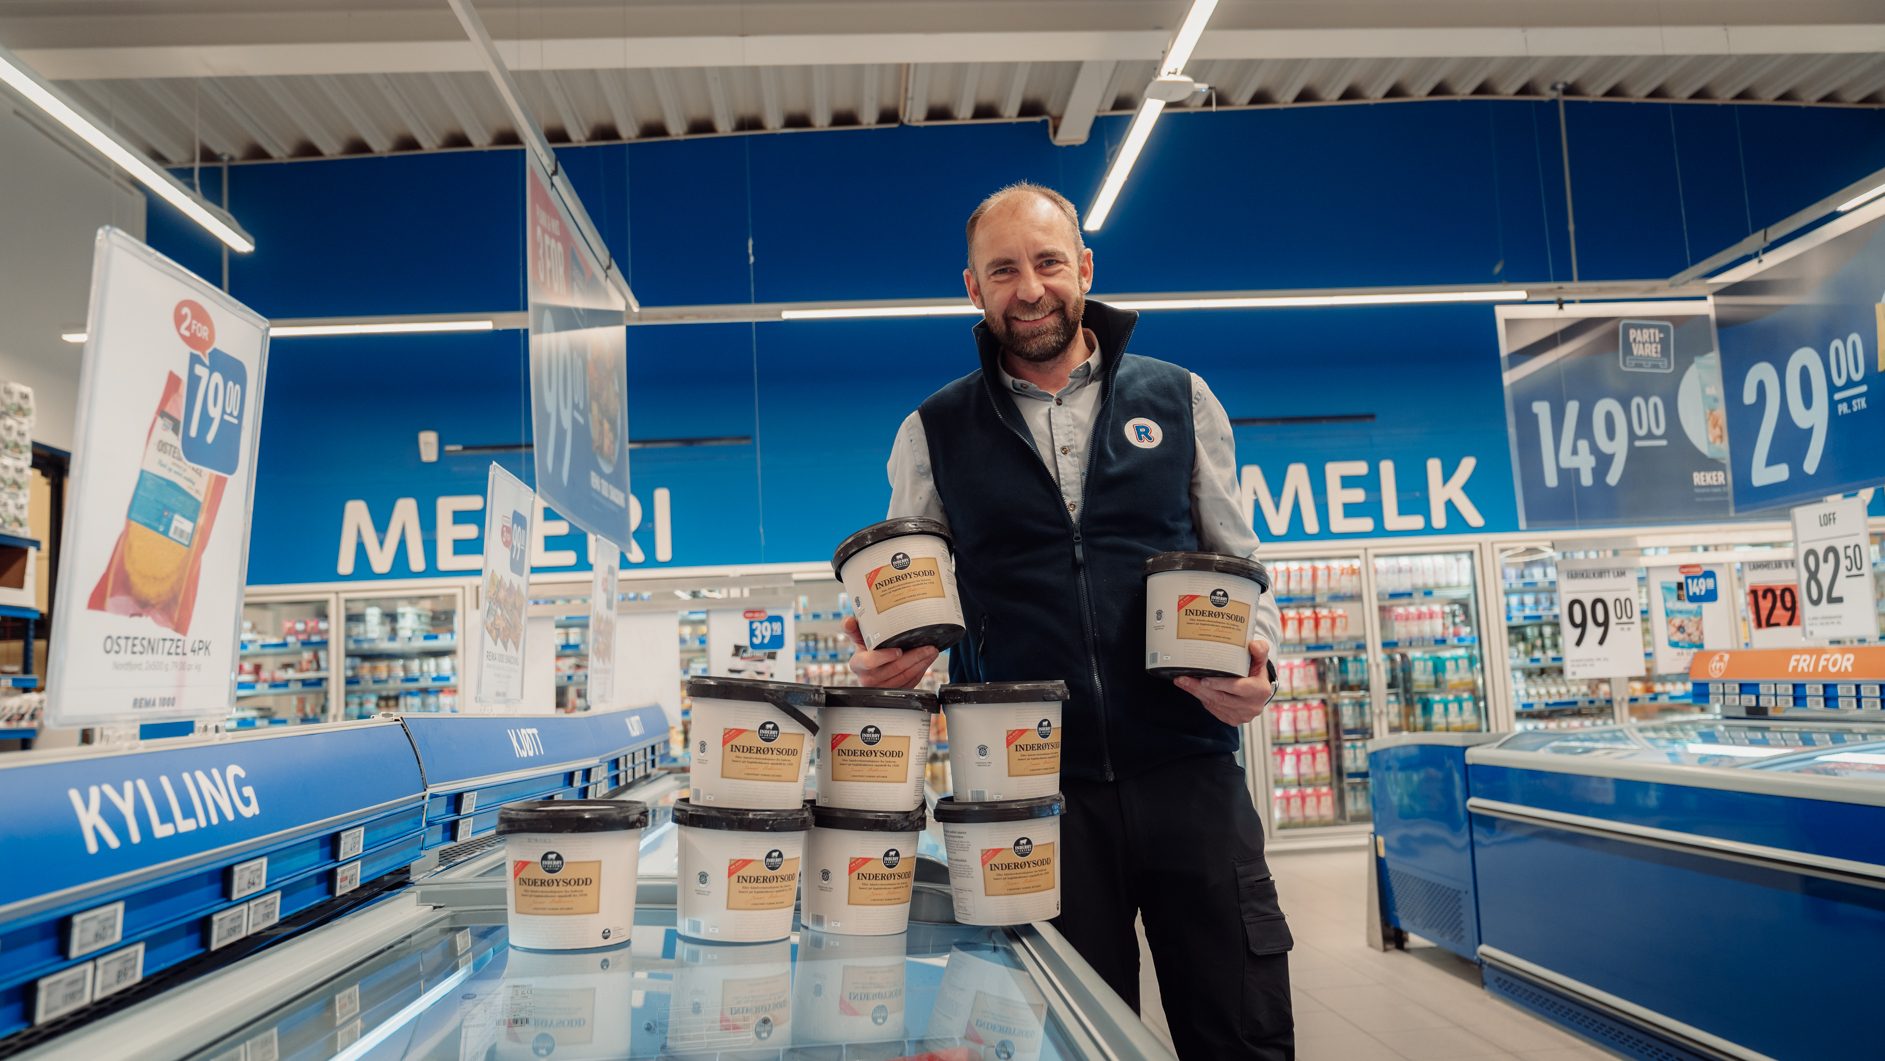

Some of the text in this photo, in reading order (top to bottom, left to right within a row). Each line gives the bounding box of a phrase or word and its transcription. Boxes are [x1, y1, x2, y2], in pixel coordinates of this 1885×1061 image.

[179, 307, 209, 340] 2 FOR
[1628, 327, 1664, 343] PARTI-
[1631, 342, 1662, 358] VARE!
[189, 363, 241, 444] 79 00
[1743, 332, 1865, 488] 29 00
[1852, 397, 1867, 413] STK
[1132, 424, 1154, 443] R
[1531, 395, 1666, 489] 149 00
[1692, 471, 1726, 486] REKER
[1240, 456, 1486, 536] MELK
[1818, 512, 1837, 527] LOFF
[875, 569, 936, 590] INDERØYSODD
[1803, 543, 1863, 606] 82 50
[1687, 578, 1706, 596] 149
[1184, 608, 1245, 624] INDERØYSODD
[1750, 587, 1797, 629] 129
[1568, 597, 1633, 647] 99 00
[752, 621, 771, 645] 39
[103, 635, 212, 656] OSTESNITZEL 4PK
[1788, 653, 1855, 673] FRI FOR
[132, 696, 176, 709] REMA 1000
[507, 727, 544, 758] KJØTT
[730, 744, 798, 757] INDERØYSODD
[837, 748, 904, 758] INDERØYSODD
[68, 764, 260, 855] KYLLING
[989, 857, 1052, 871] INDERØYSODD
[518, 877, 593, 887] INDERØYSODD
[736, 872, 796, 884] INDERØYSODD
